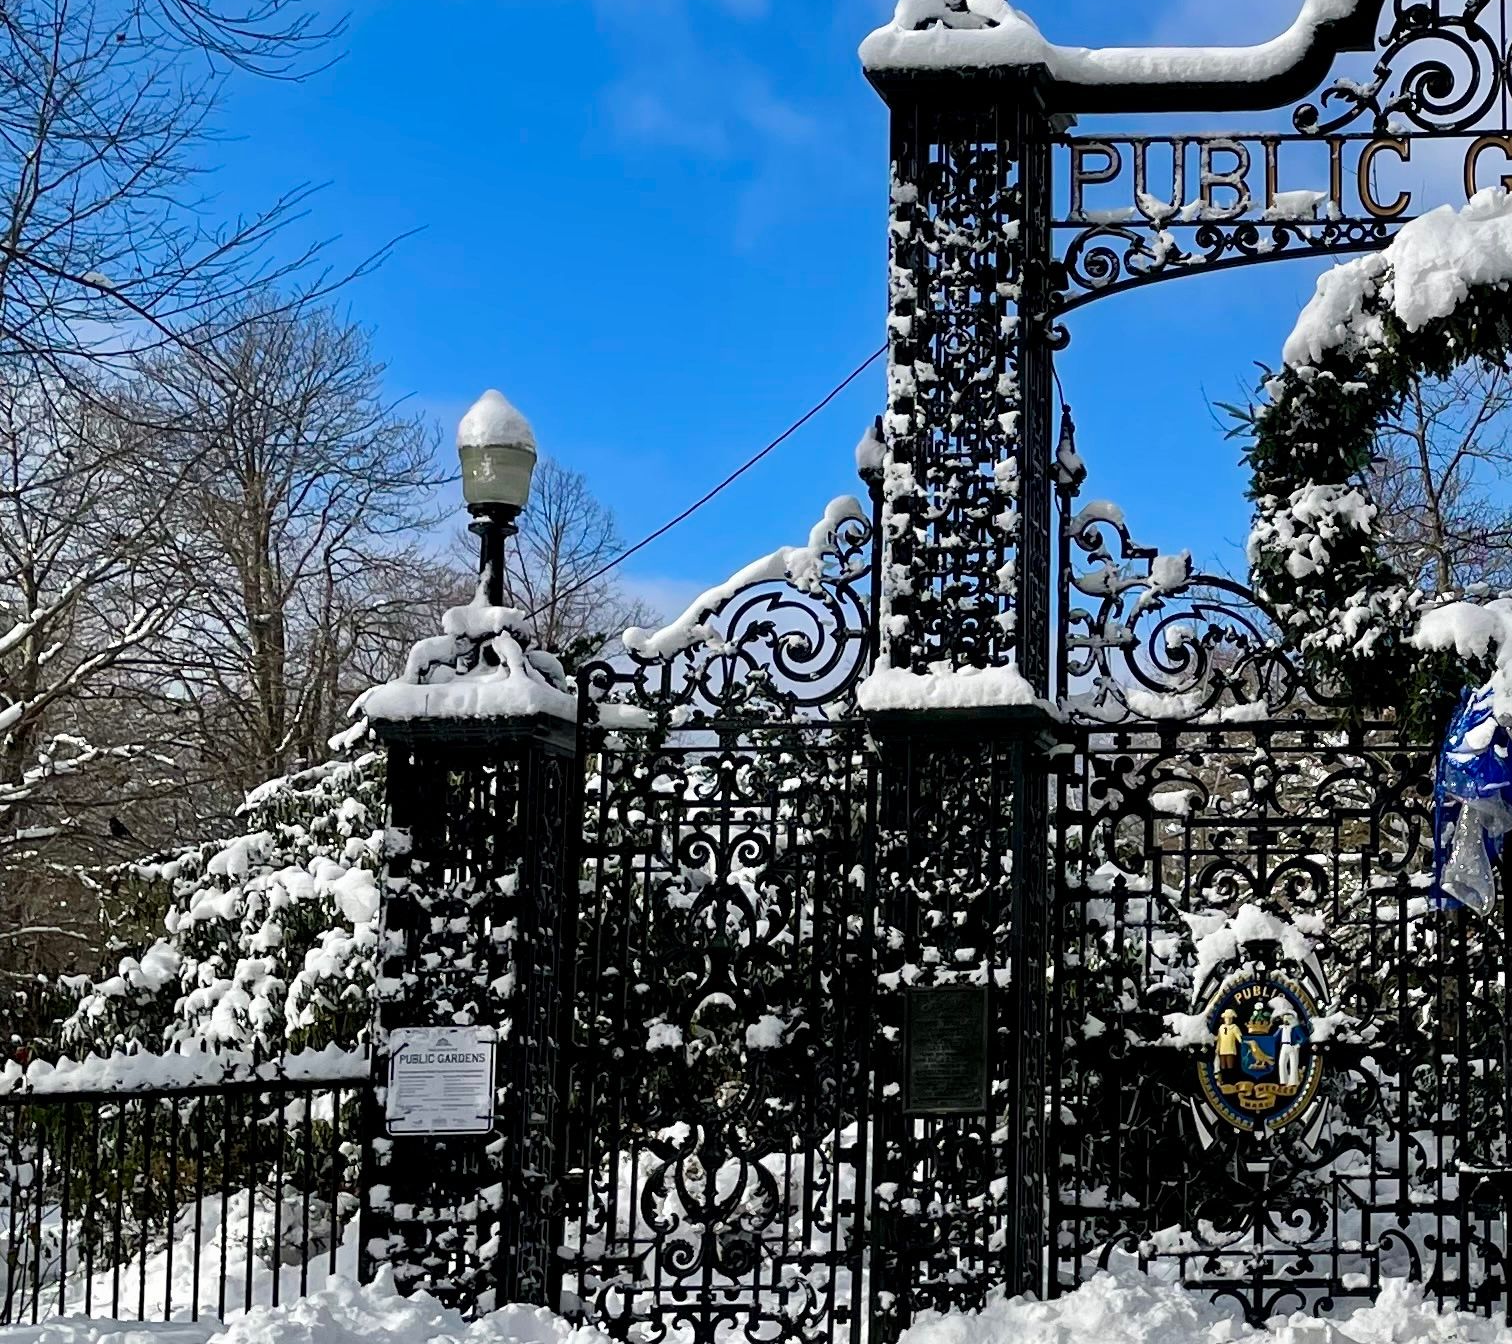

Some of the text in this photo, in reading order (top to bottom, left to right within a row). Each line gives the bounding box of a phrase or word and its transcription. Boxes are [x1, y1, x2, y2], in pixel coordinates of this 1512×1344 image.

[1069, 137, 1412, 226] PUBLIC
[400, 1053, 486, 1065] PUBLIC GARDENS
